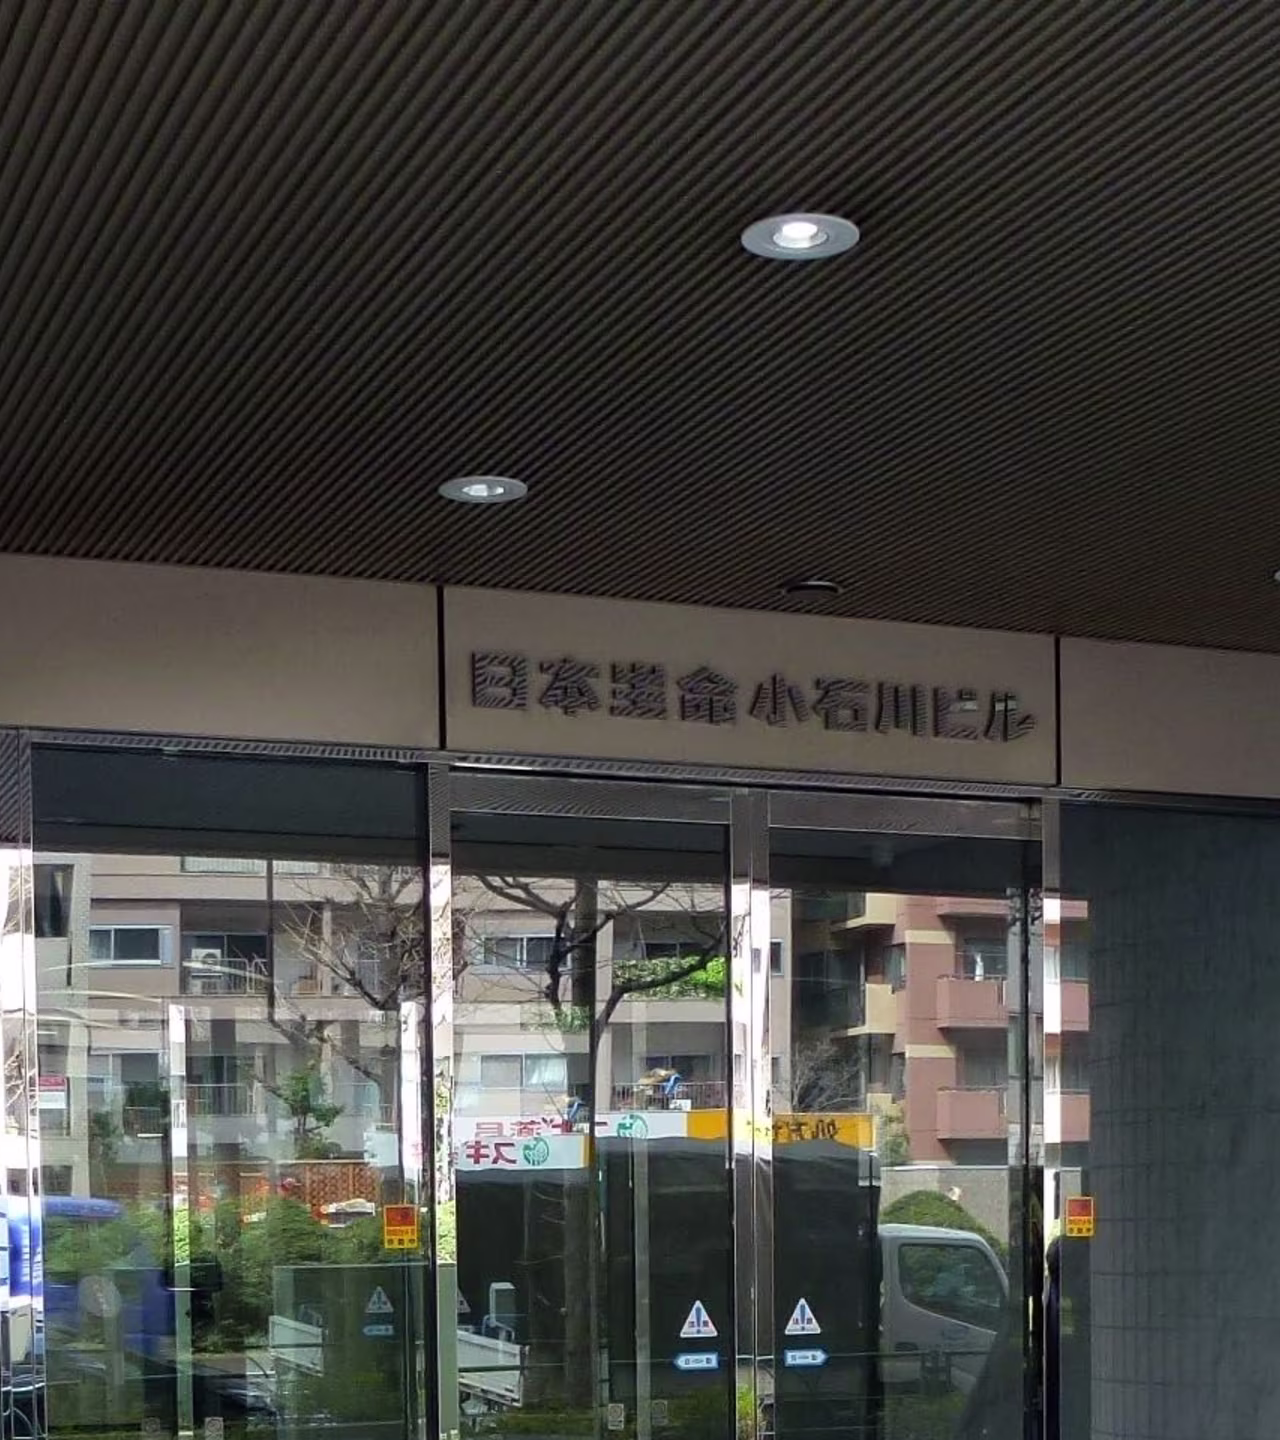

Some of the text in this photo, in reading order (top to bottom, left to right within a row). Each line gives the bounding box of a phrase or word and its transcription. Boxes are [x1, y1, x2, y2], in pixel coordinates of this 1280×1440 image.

[471, 653, 1035, 741] 日本生命小石川ビル
